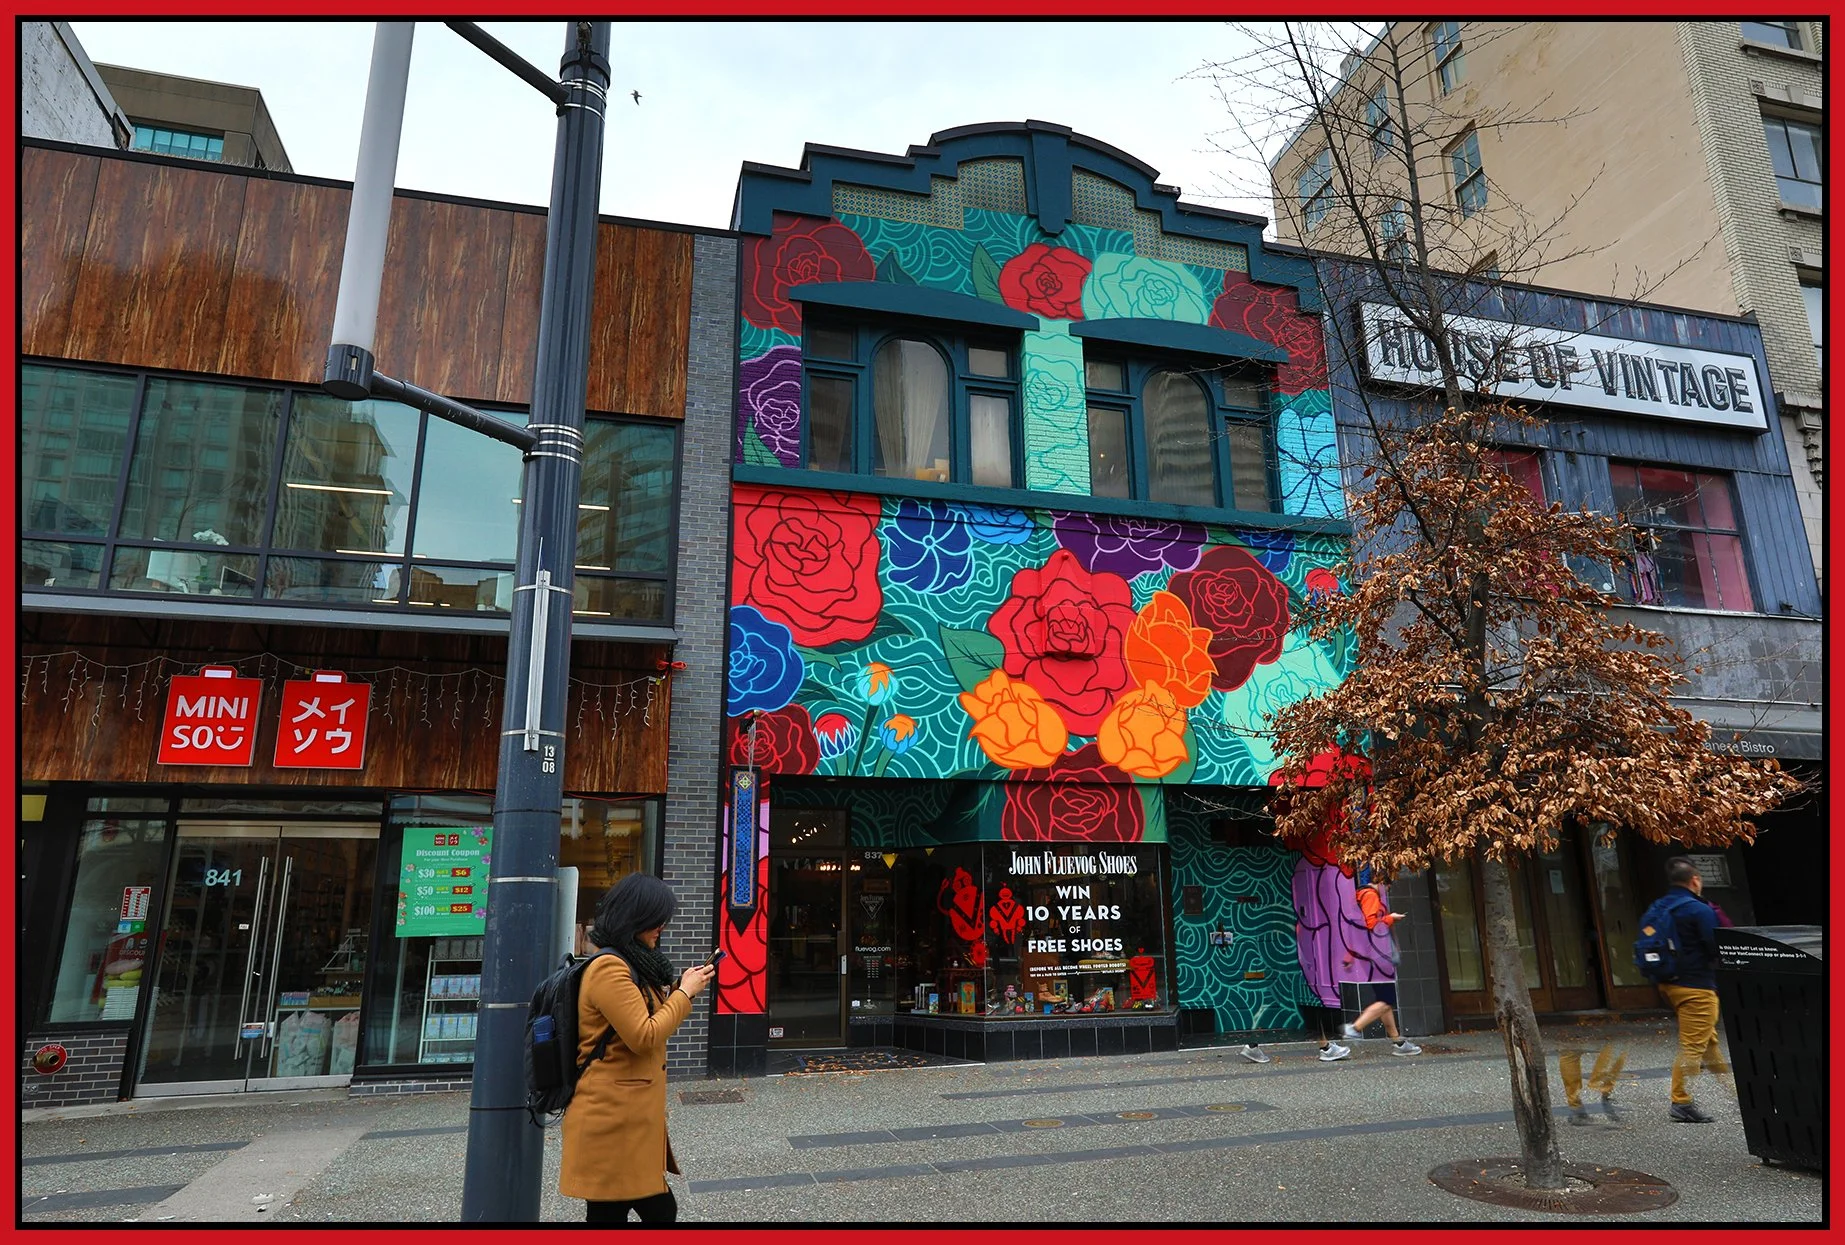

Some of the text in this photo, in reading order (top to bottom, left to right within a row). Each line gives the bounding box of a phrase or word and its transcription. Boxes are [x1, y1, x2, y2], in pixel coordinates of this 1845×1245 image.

[1377, 319, 1754, 413] HOUSE OF VINTAGE
[176, 695, 249, 719] MINI
[292, 697, 356, 725] メイ
[293, 727, 352, 754] ソウ
[1740, 740, 1775, 754] Bistro
[544, 745, 555, 758] 13
[542, 761, 555, 773] 08
[416, 849, 480, 857] Discount Coupon
[864, 851, 883, 859] 837
[1008, 850, 1138, 875] JOHN FLUEVOG SHOES
[205, 868, 242, 887] 841
[418, 868, 435, 878] $30
[416, 886, 434, 896] $50
[1055, 885, 1091, 900] WIN
[414, 905, 435, 916] $100
[1026, 905, 1122, 921] 10 YEARS
[1068, 925, 1081, 934] OF
[1027, 938, 1123, 953] FREE SHOES
